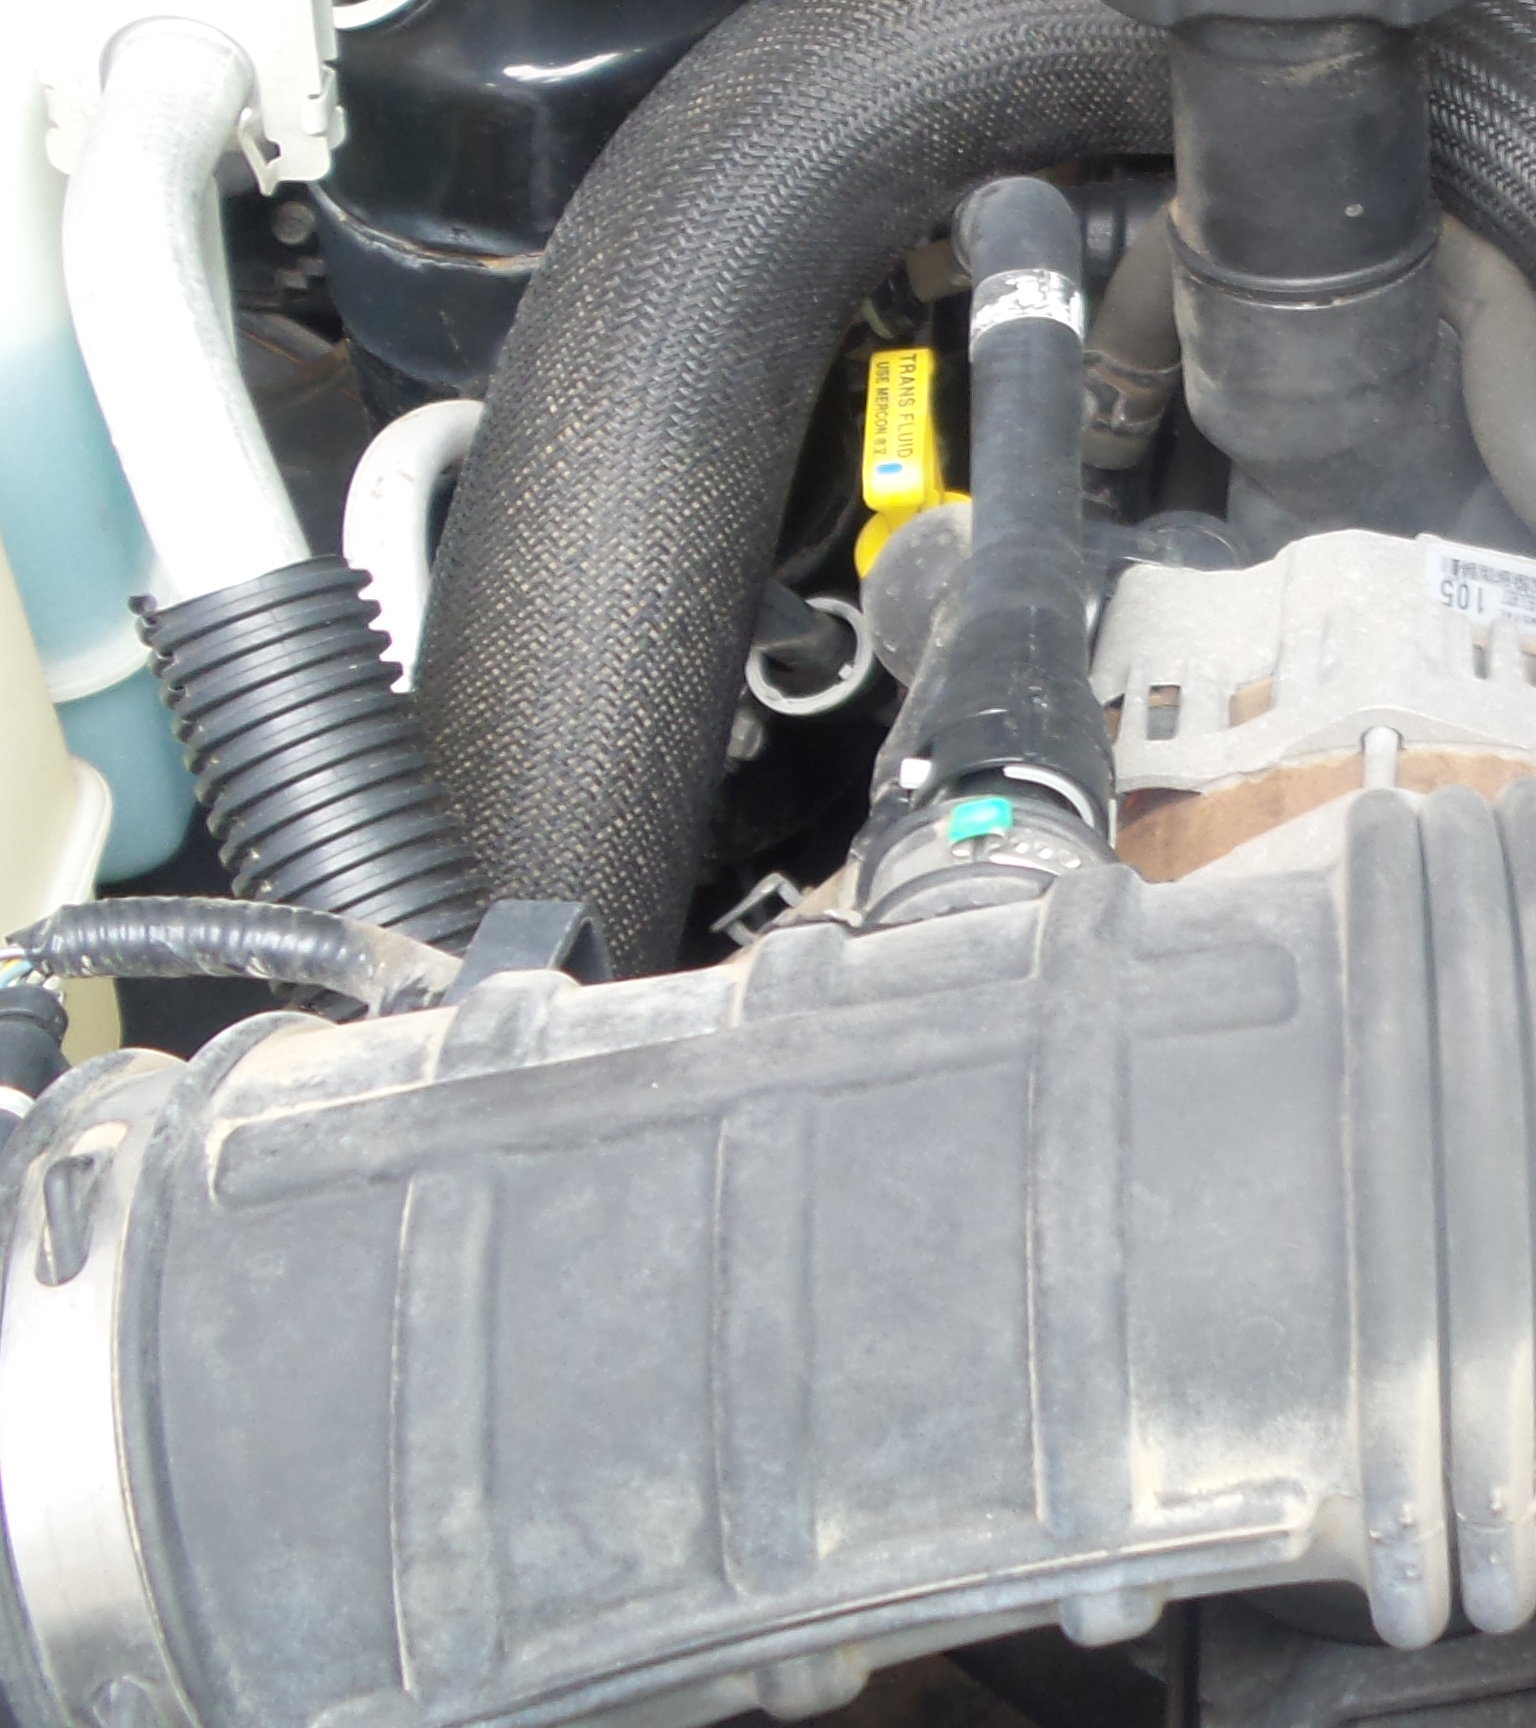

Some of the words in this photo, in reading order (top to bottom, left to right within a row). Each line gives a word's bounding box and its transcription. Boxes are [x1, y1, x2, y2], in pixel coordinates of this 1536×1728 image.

[874, 361, 890, 384] USE
[897, 353, 917, 408] TRANS
[896, 412, 915, 459] FLUID
[1440, 578, 1485, 614] 105
